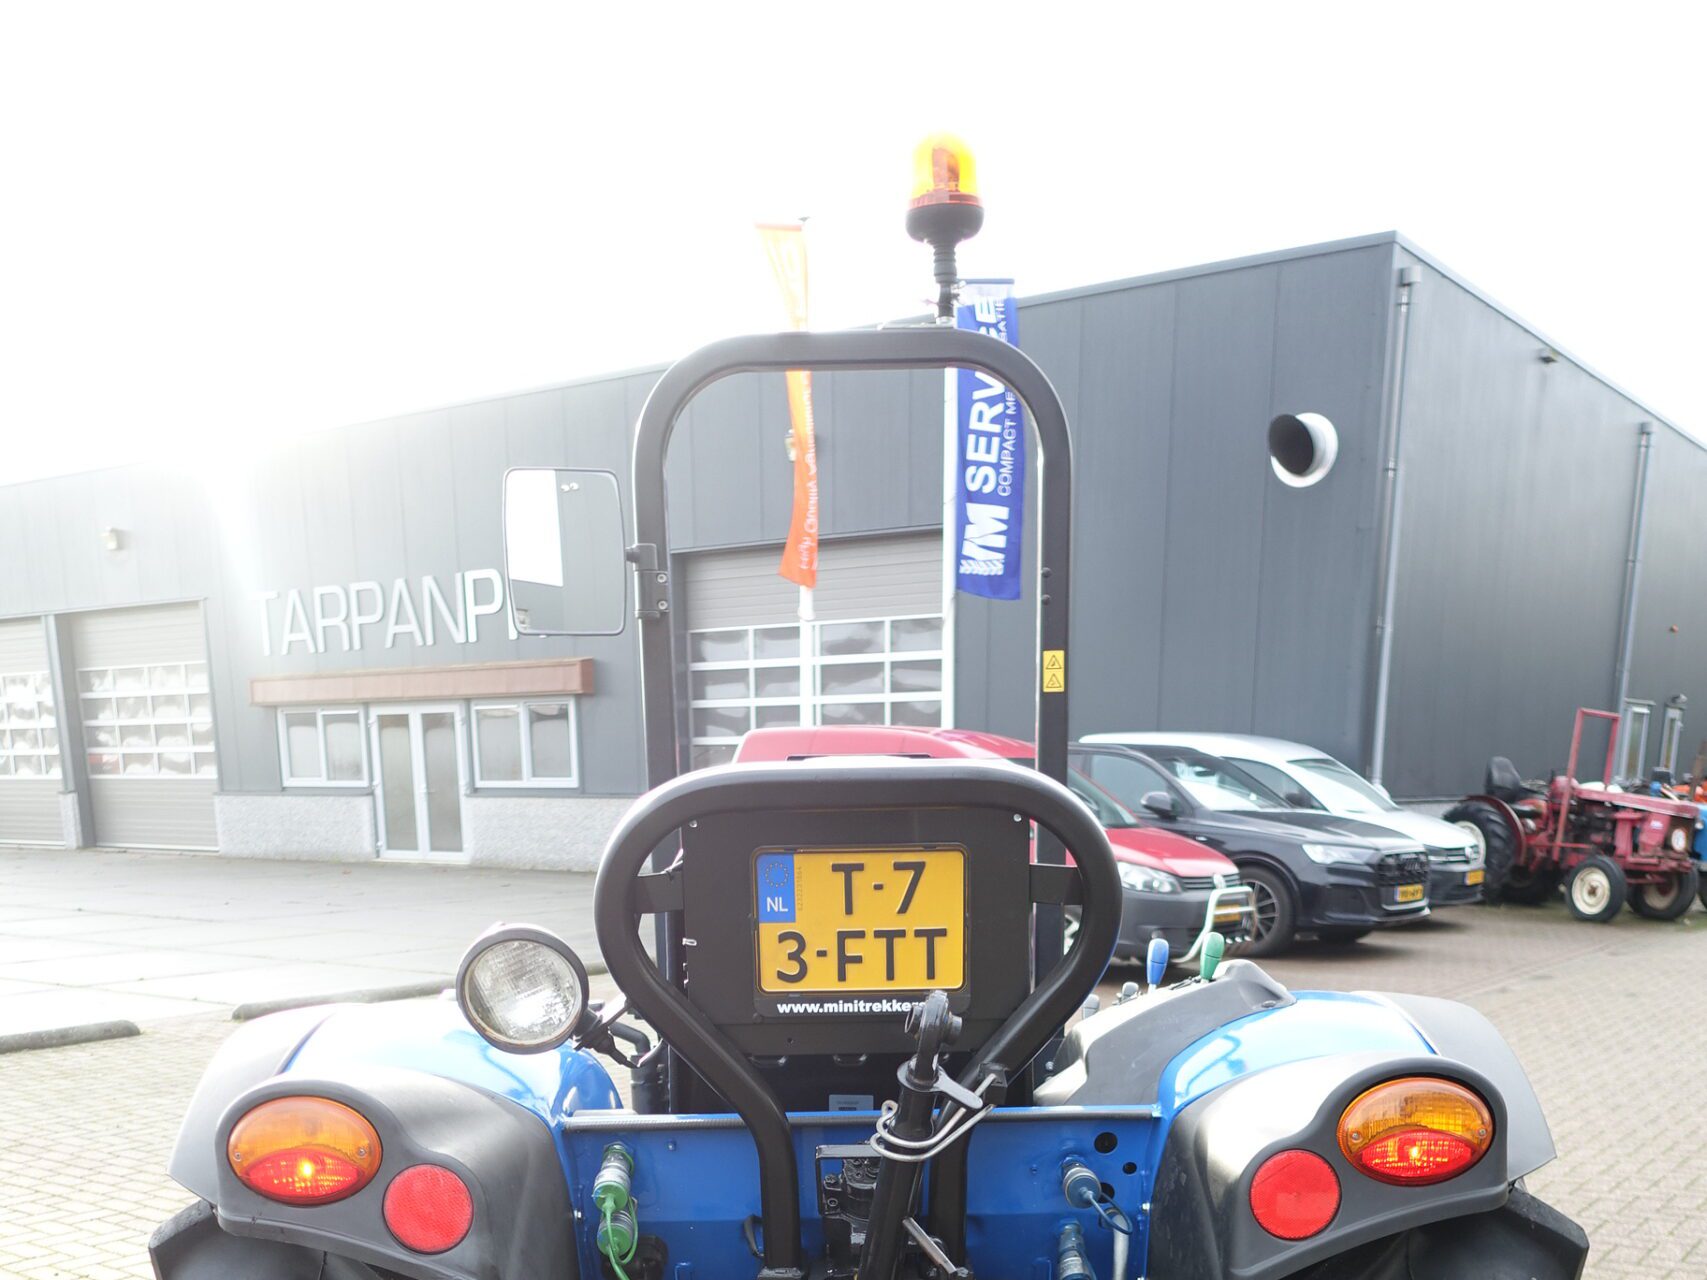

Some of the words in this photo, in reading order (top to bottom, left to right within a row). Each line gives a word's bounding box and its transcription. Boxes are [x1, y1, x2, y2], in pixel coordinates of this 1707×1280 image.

[965, 297, 1005, 494] SERVE
[997, 418, 1016, 497] COMPACT
[247, 568, 547, 656] TARPANP
[766, 896, 789, 913] NL
[830, 860, 927, 916] T-7
[776, 927, 947, 984] 3-FTT
